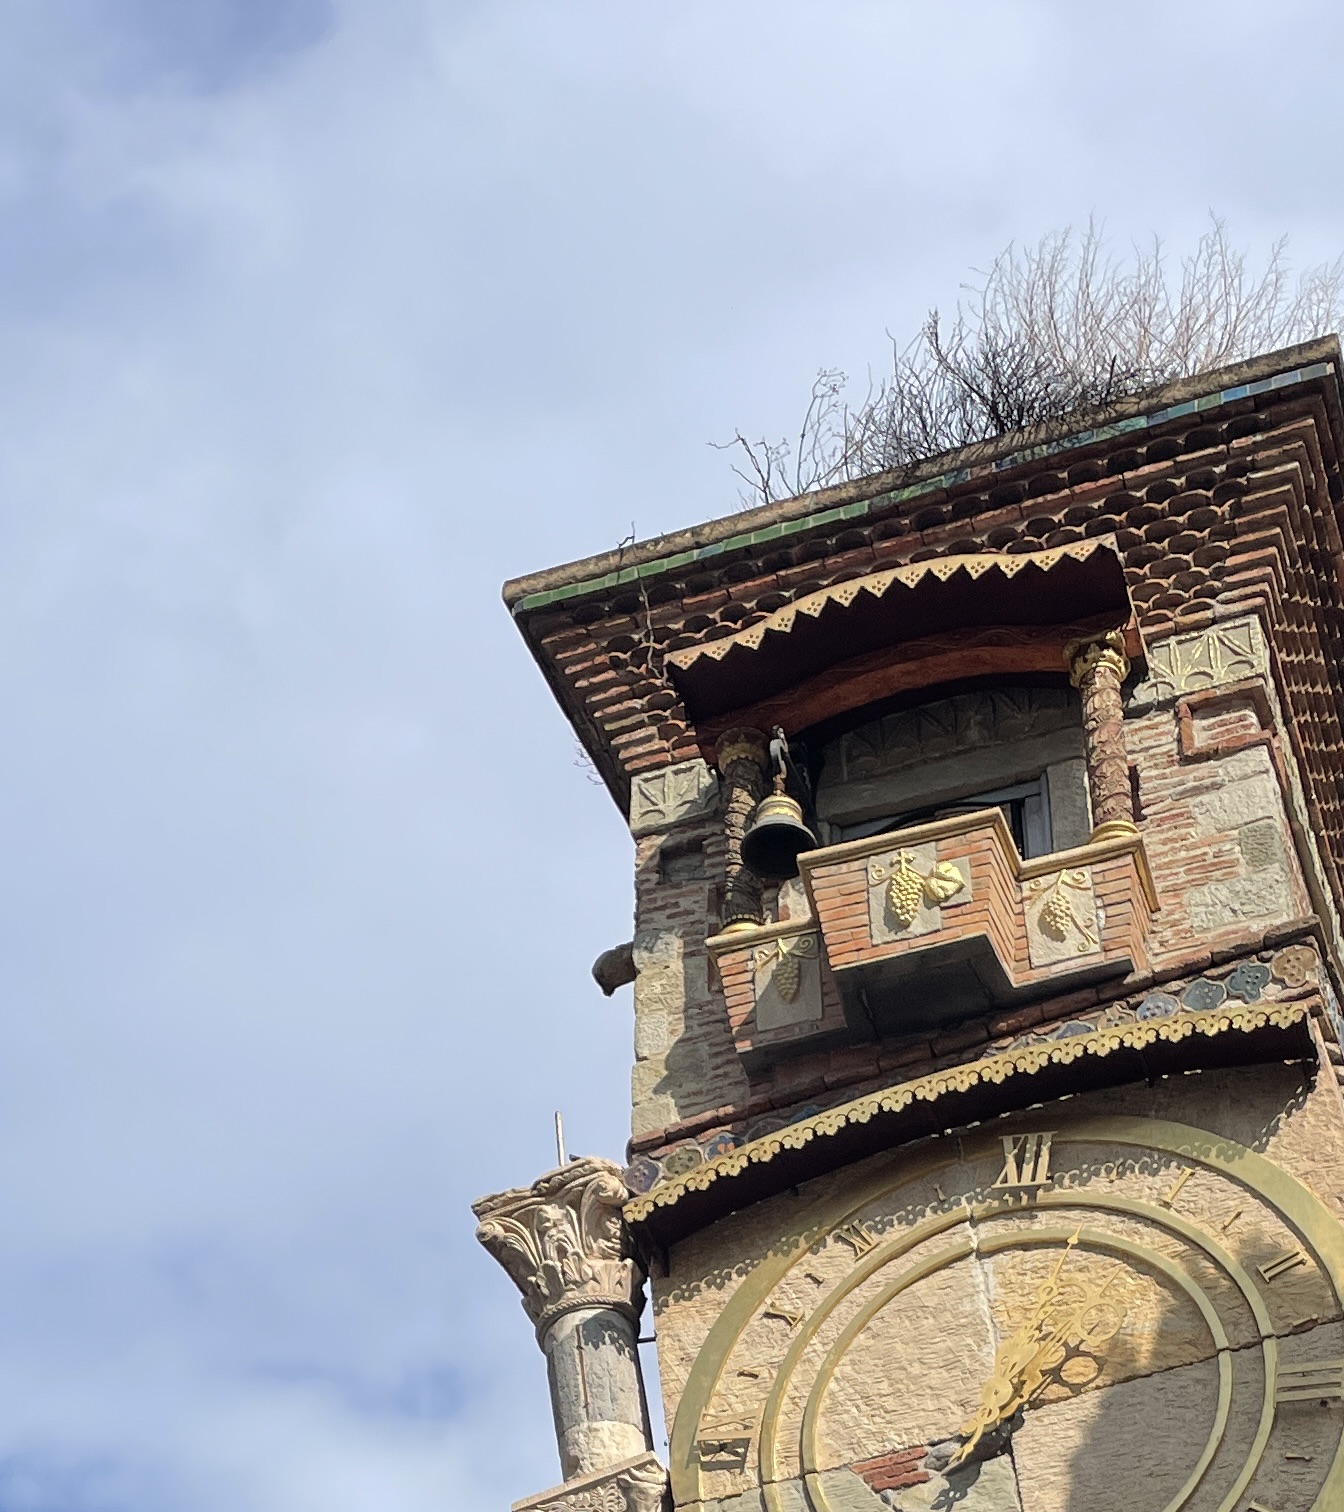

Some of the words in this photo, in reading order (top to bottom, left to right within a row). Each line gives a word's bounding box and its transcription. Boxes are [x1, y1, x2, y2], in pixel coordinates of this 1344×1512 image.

[991, 1131, 1058, 1188] XII
[1159, 1166, 1196, 1204] I
[836, 1219, 881, 1261] XI
[1256, 1244, 1308, 1283] II
[764, 1297, 805, 1328] X
[694, 1402, 762, 1446] IX
